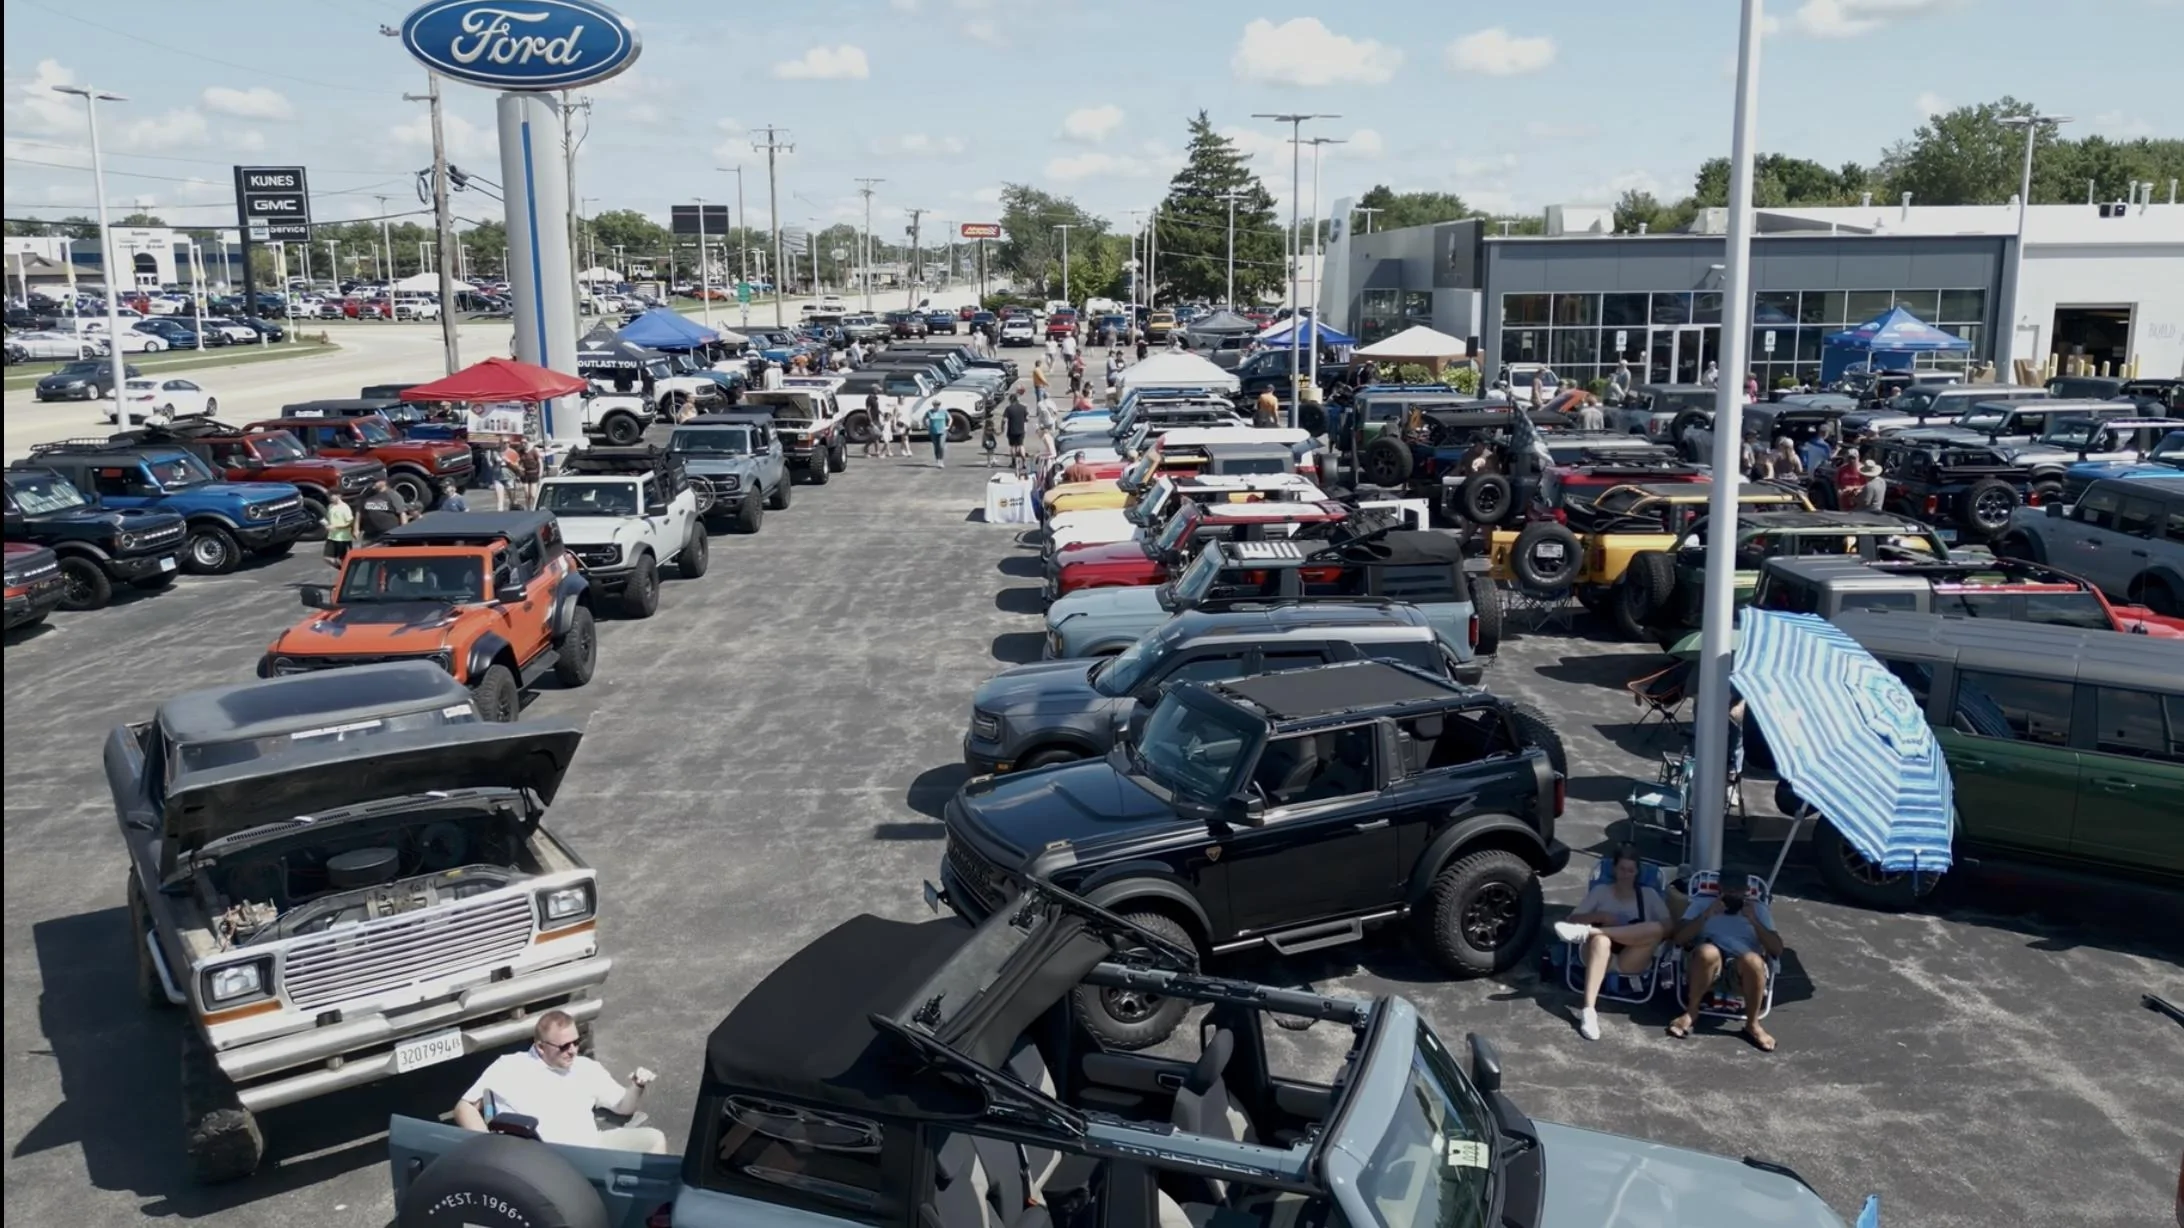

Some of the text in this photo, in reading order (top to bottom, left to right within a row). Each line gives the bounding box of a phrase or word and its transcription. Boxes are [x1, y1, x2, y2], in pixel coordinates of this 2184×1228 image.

[451, 8, 584, 64] Ford
[250, 175, 295, 187] KUNES
[254, 200, 297, 211] GMC
[577, 360, 638, 369] OUTLAST YOU
[445, 1192, 518, 1219] EST. 1966
